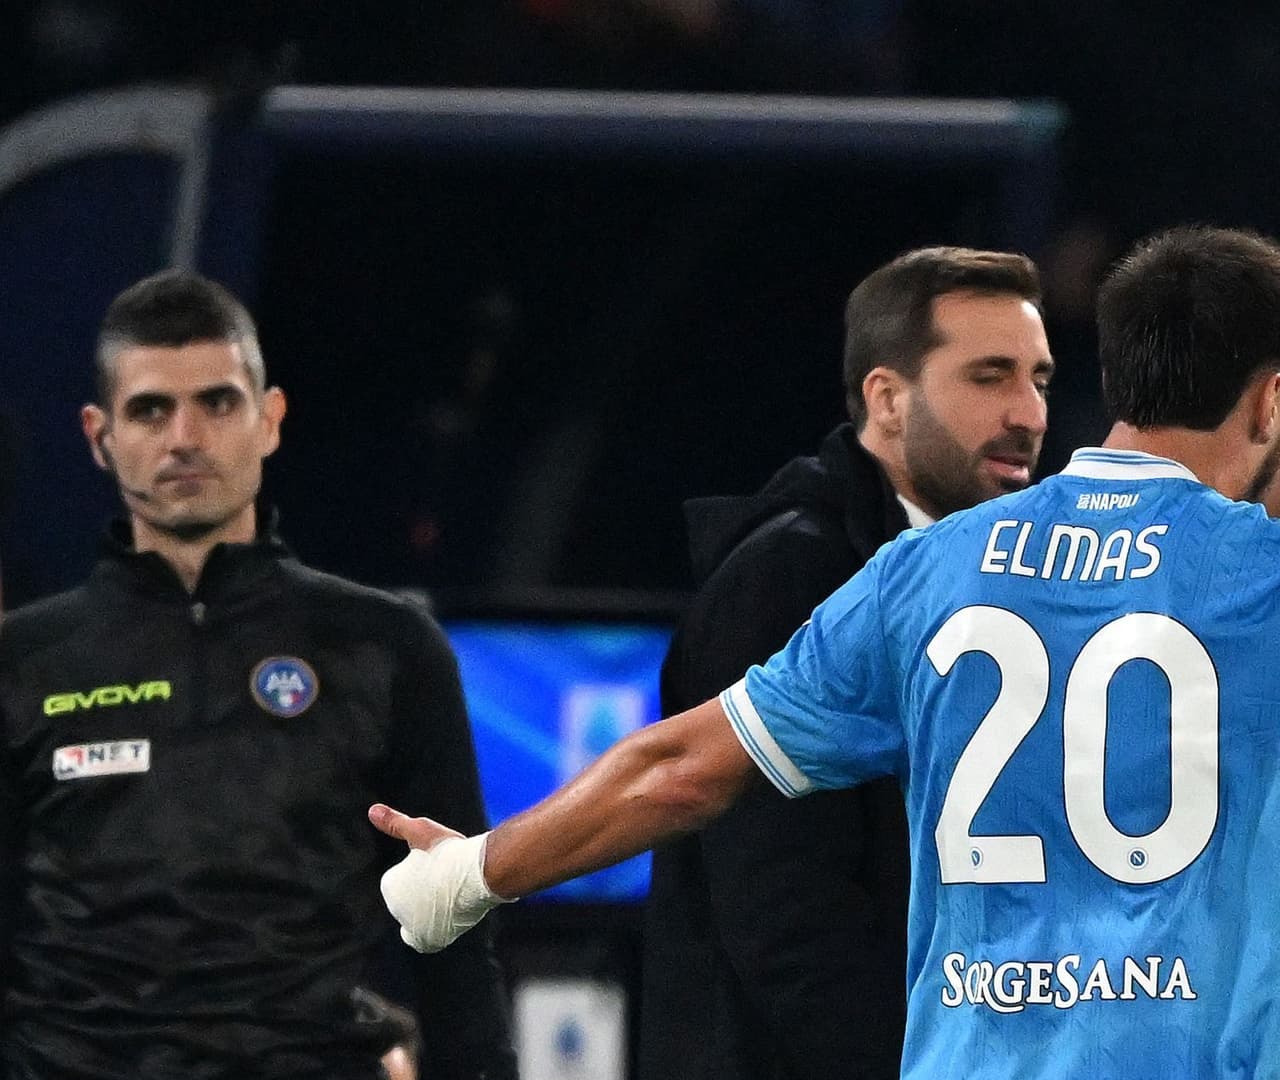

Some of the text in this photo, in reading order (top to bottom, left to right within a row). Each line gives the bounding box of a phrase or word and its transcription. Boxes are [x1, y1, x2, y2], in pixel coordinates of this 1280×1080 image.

[1088, 493, 1140, 511] NAPOLI
[980, 519, 1169, 581] ELMAS
[43, 680, 172, 717] GIVOVA
[926, 604, 1220, 885] 20
